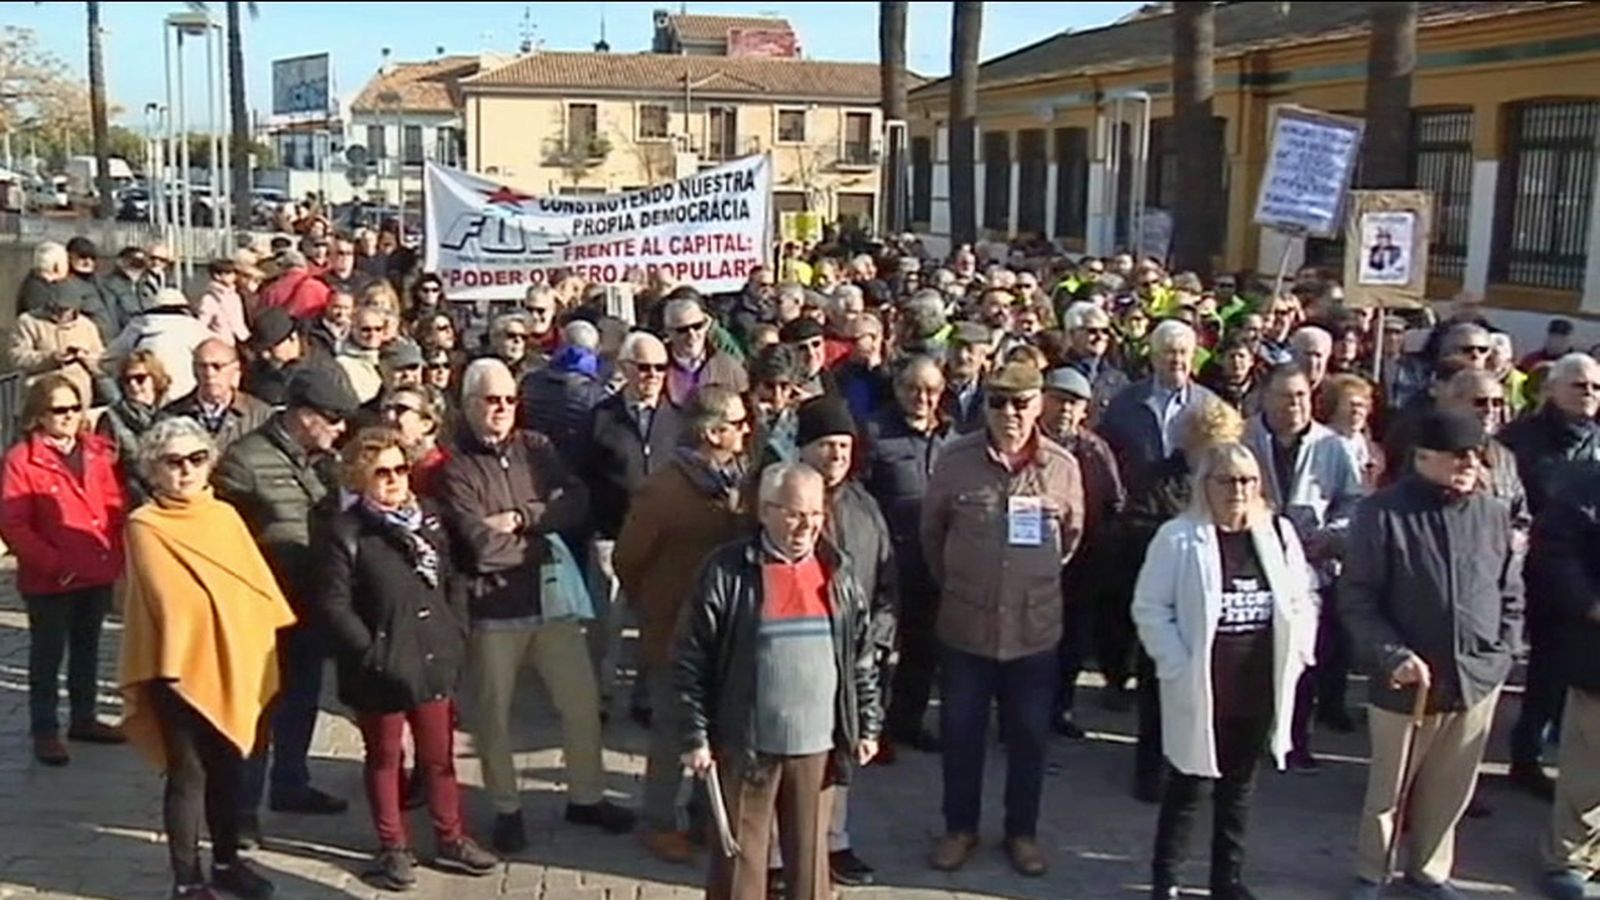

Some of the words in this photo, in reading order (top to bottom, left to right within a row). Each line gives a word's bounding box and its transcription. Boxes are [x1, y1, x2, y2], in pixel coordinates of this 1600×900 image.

[678, 169, 755, 200] NUESTRA
[572, 213, 635, 236] PROPIA
[563, 238, 635, 261] FRENTE
[641, 237, 663, 256] AL
[669, 233, 751, 256] CAPITAL:
